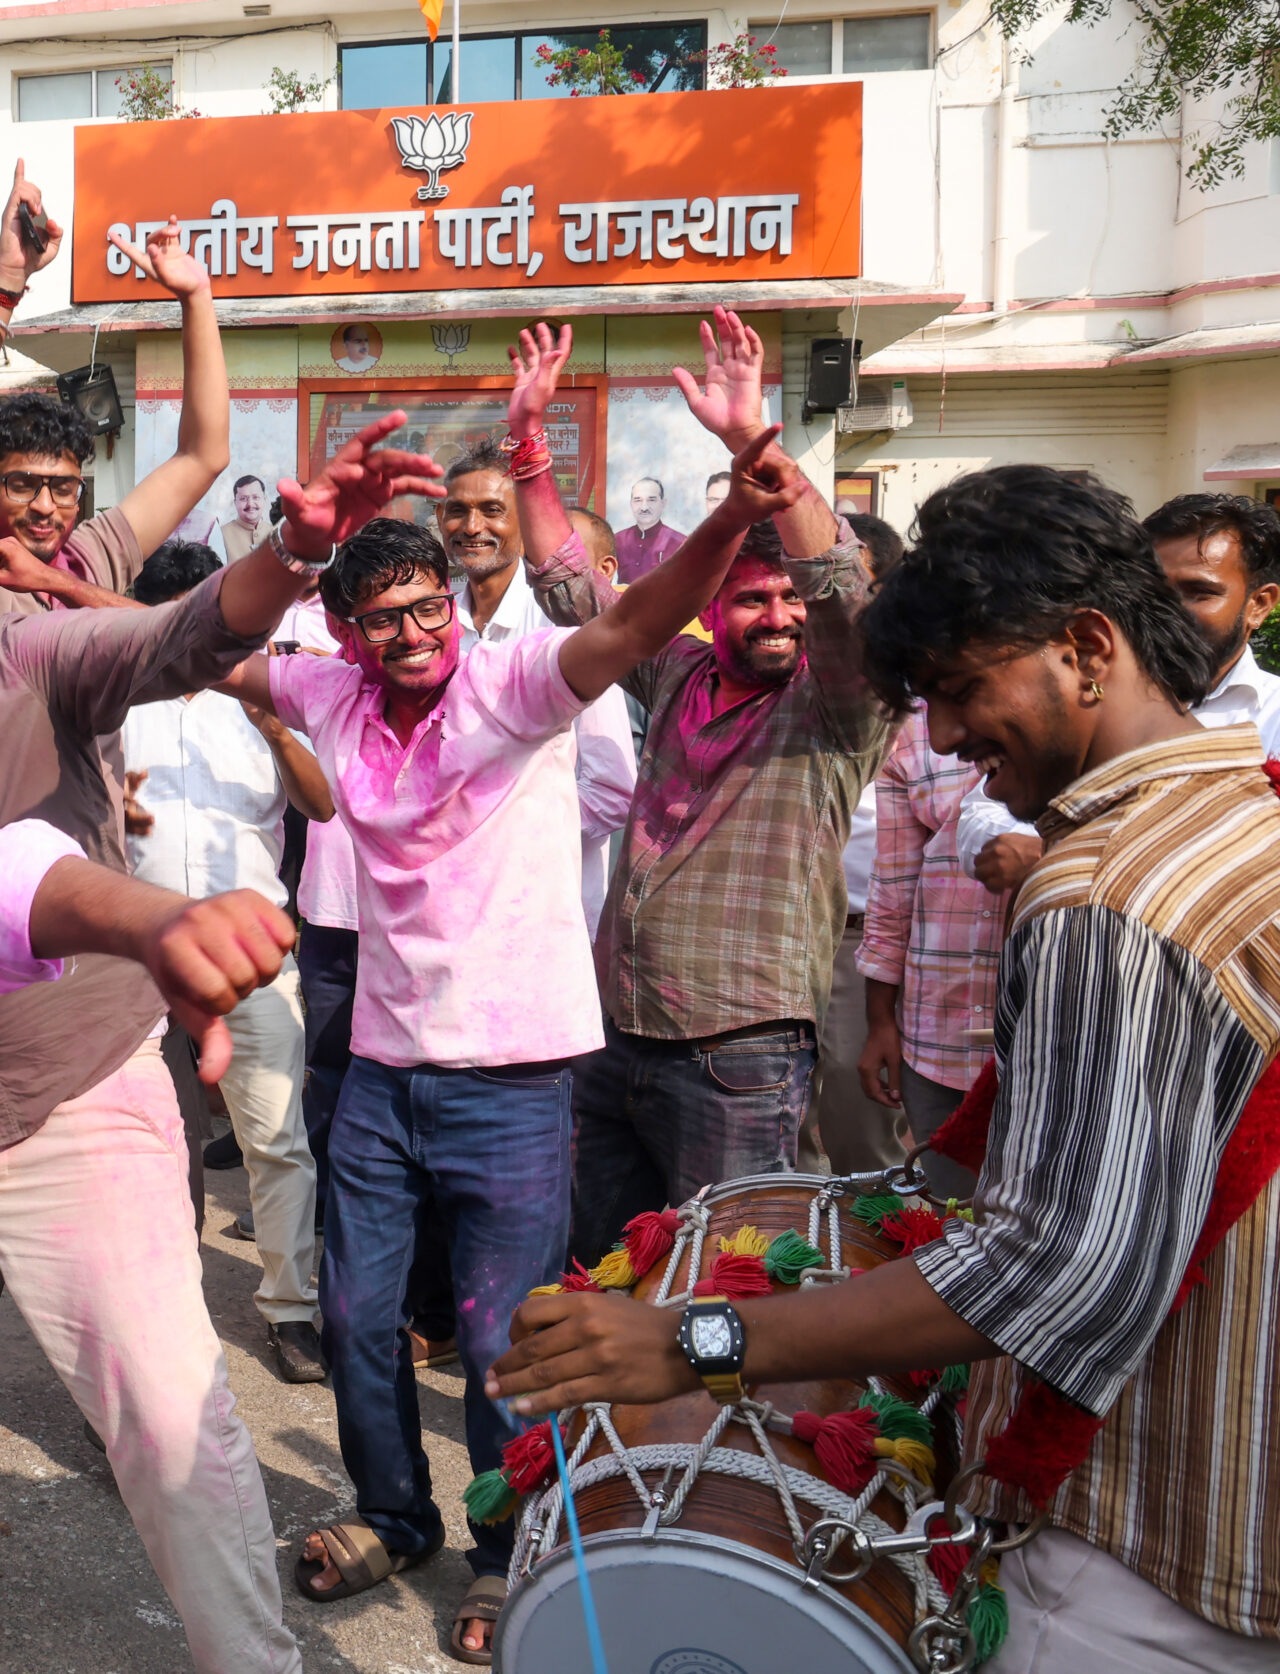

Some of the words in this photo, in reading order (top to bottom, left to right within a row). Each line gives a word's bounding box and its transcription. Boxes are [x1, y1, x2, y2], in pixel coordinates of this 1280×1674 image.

[107, 199, 279, 279] भतीय
[287, 210, 425, 272] जनता
[434, 184, 544, 277] पार्टी,
[559, 194, 799, 263] राजस्थान
